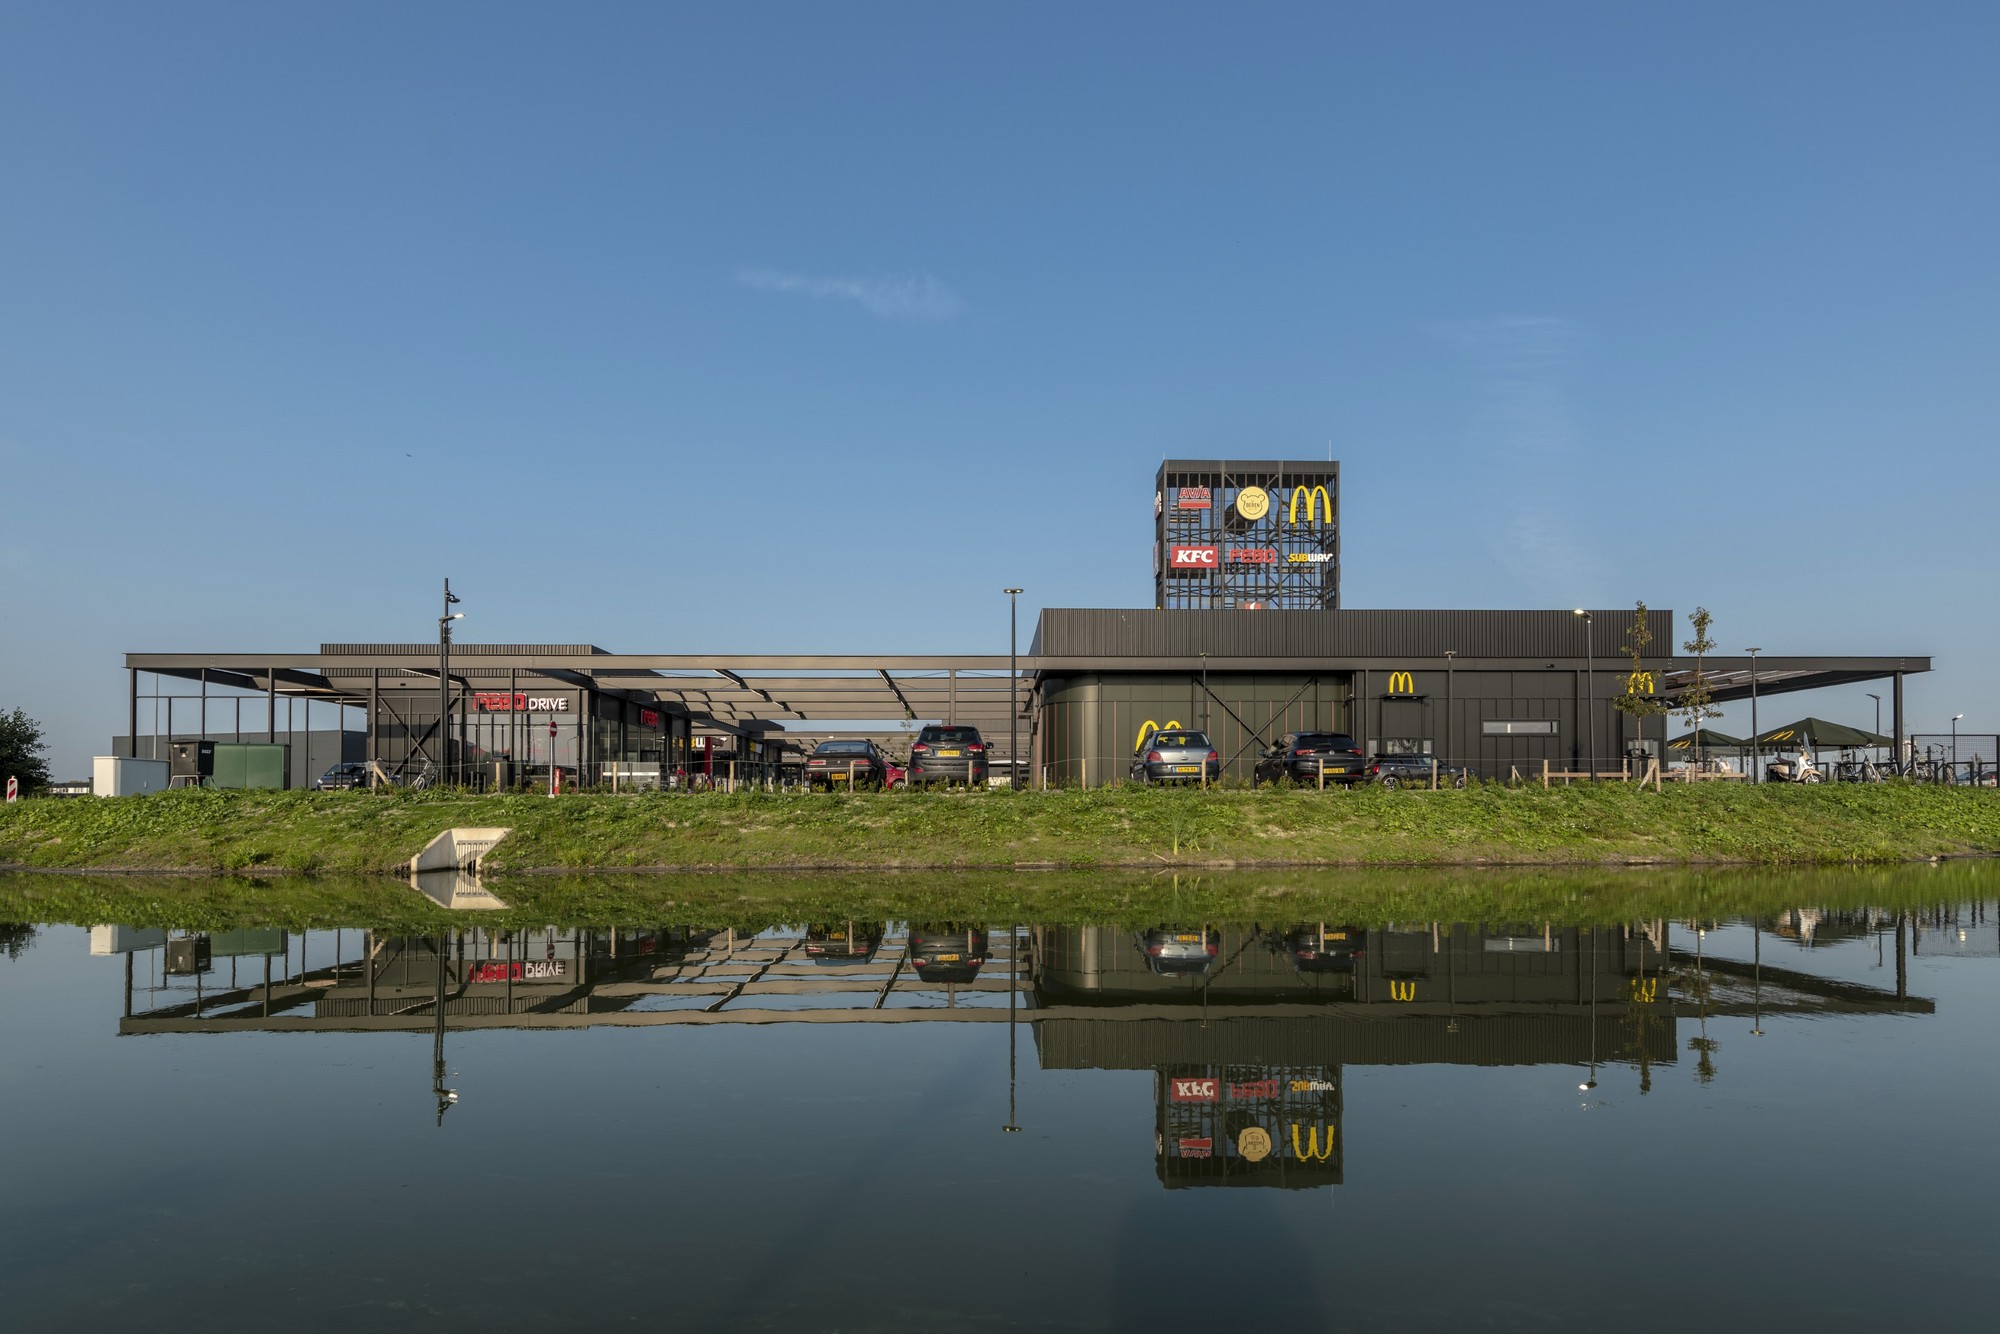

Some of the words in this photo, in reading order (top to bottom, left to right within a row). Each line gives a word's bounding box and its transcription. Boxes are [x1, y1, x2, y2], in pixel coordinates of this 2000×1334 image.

[1179, 486, 1211, 498] AVIA
[1176, 550, 1213, 563] KFC
[1229, 549, 1276, 563] FEBO
[1288, 553, 1333, 563] SUBWAY
[528, 697, 568, 711] DRIVE
